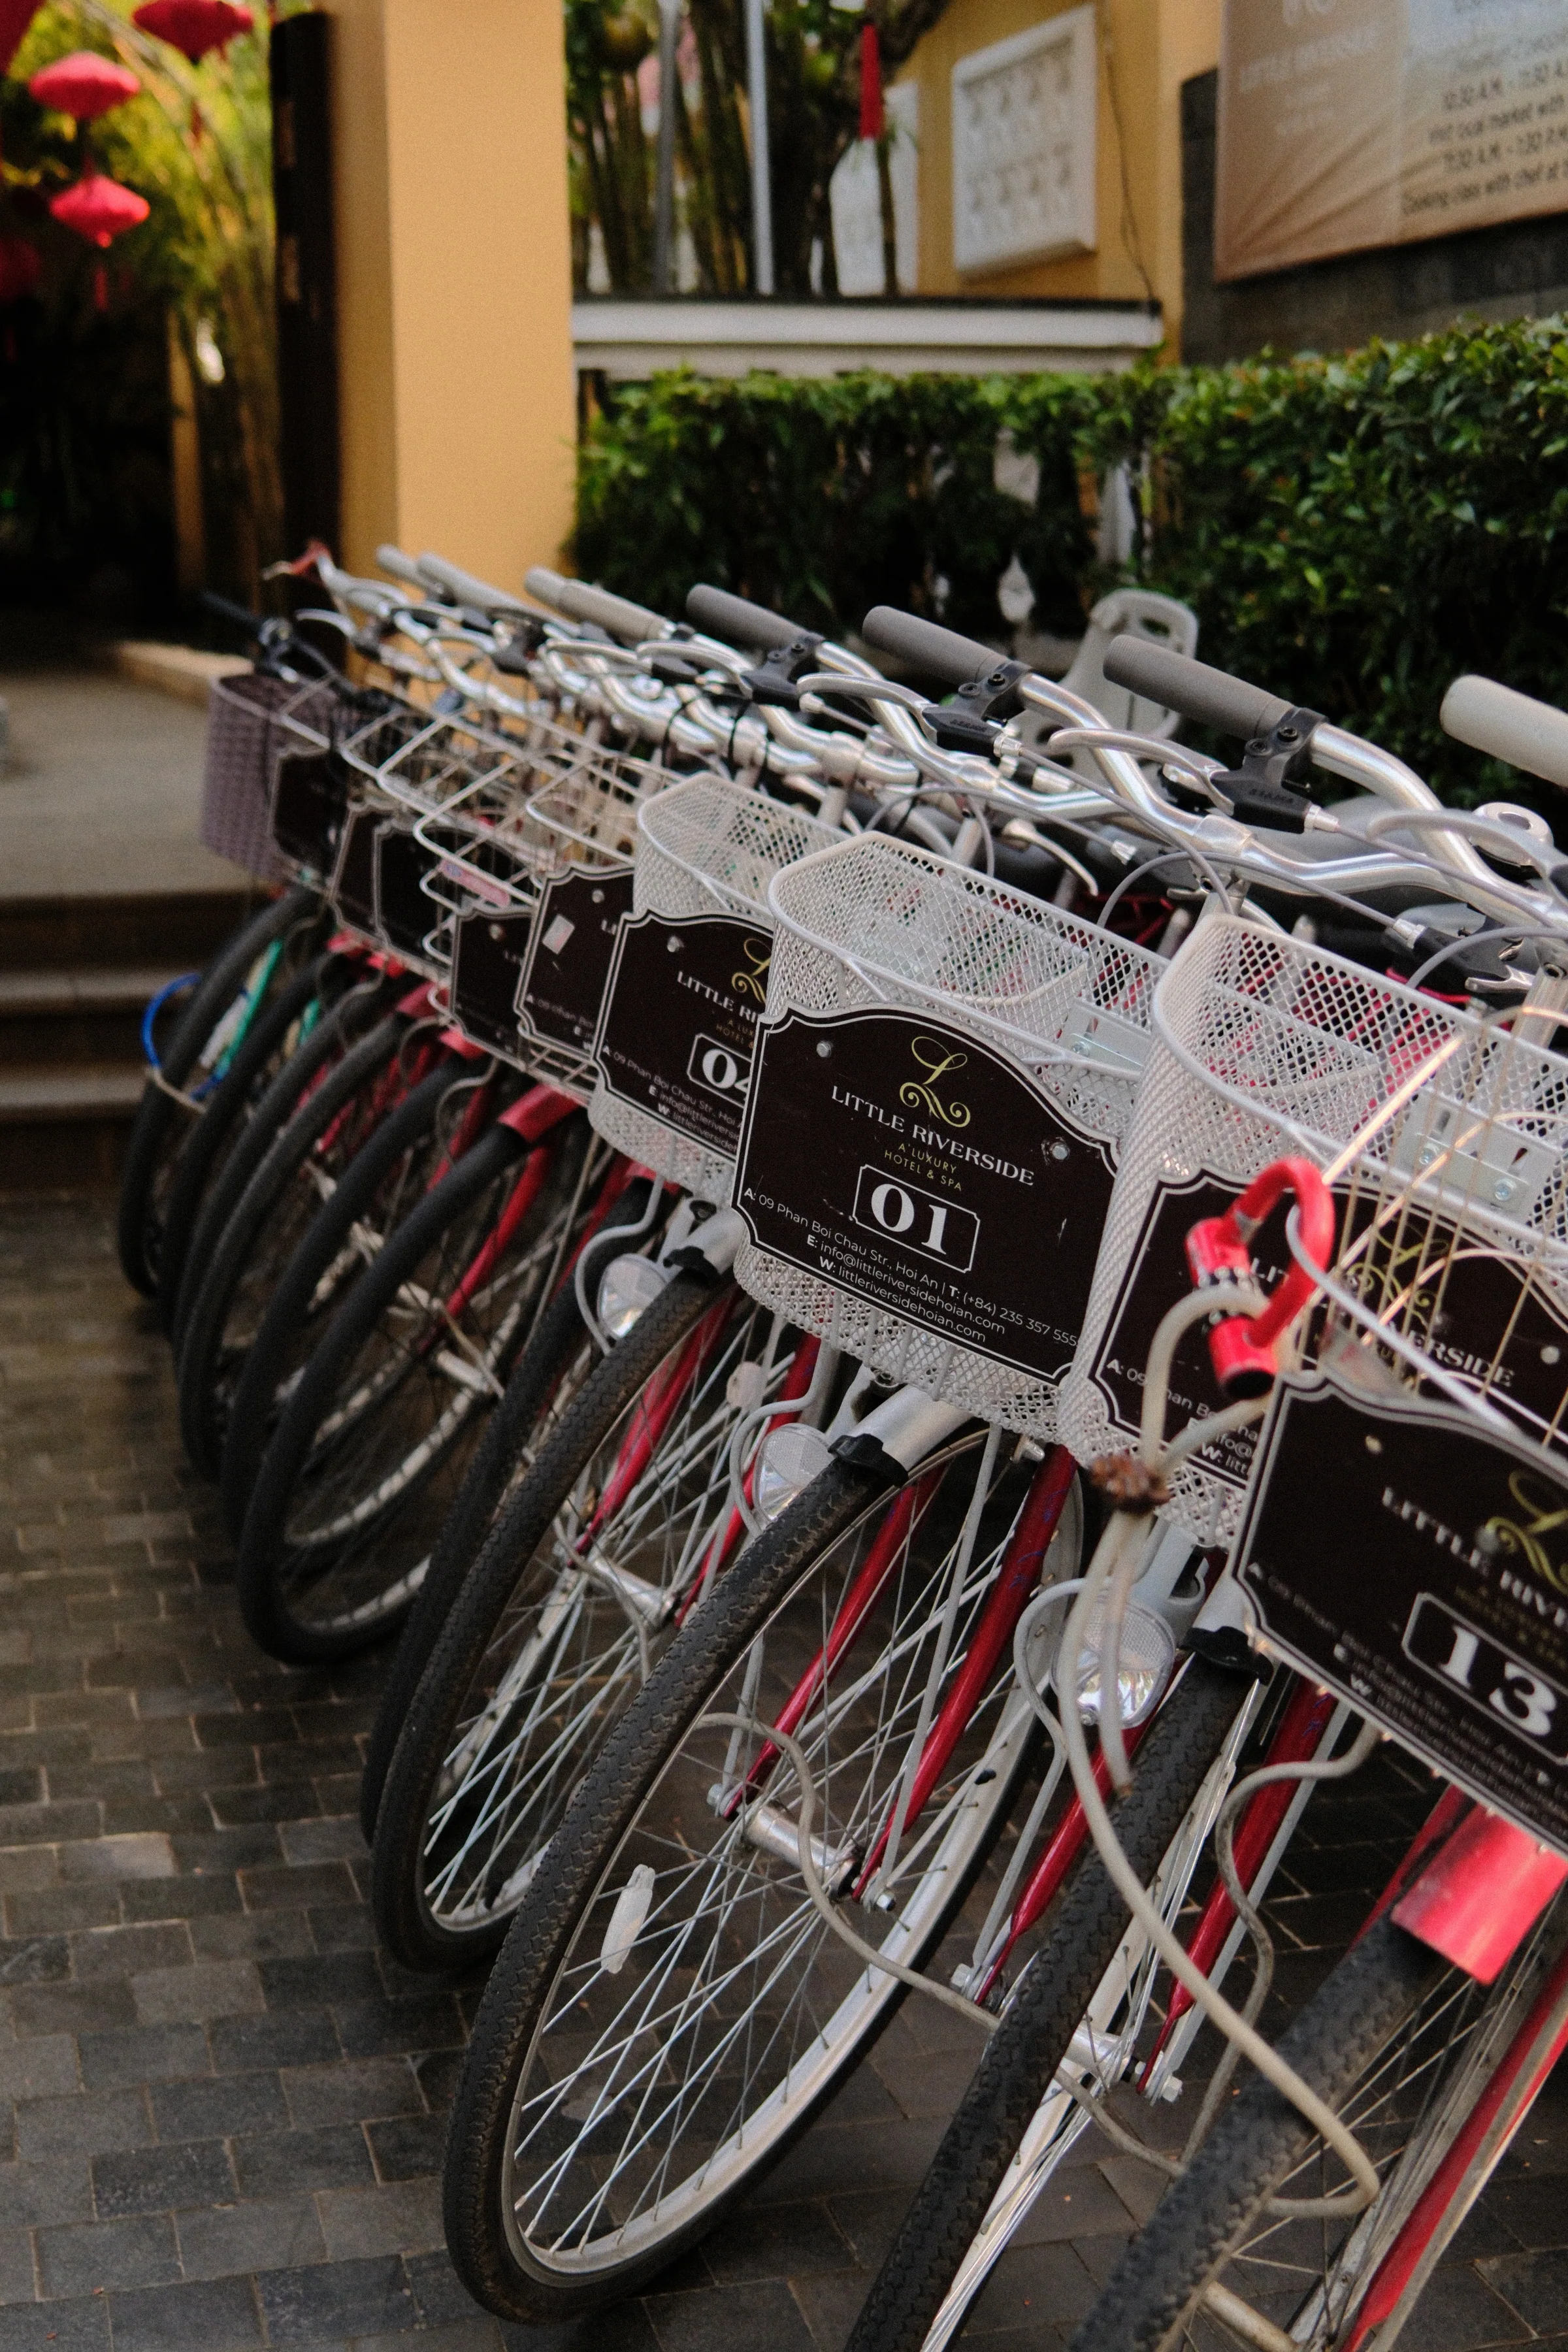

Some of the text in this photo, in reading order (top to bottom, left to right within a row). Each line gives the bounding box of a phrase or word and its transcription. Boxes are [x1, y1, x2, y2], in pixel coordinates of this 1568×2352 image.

[677, 971, 735, 1012] LITTLE
[831, 1085, 1035, 1186] LITTLE RIVERSIDE
[884, 1150, 962, 1192] HOTEL & SPA
[911, 1148, 957, 1174] LUXURY
[871, 1183, 947, 1254] 01
[744, 1187, 756, 1201] A:
[759, 1194, 774, 1209] 09
[777, 1203, 808, 1228] Phan
[812, 1220, 832, 1239] Boi
[834, 1232, 867, 1256] Chau
[896, 1262, 917, 1281] Hoi
[920, 1273, 938, 1290] An
[949, 1285, 960, 1299] T:
[963, 1292, 996, 1316] (+84)
[1000, 1307, 1023, 1326] 235
[1026, 1318, 1051, 1335] 357
[1053, 1328, 1079, 1347] 555
[807, 1234, 1005, 1335] E: info@littleriversidehoian.com
[819, 1256, 986, 1343] W: littleriversidehoian.com
[1439, 1624, 1557, 1737] 13
